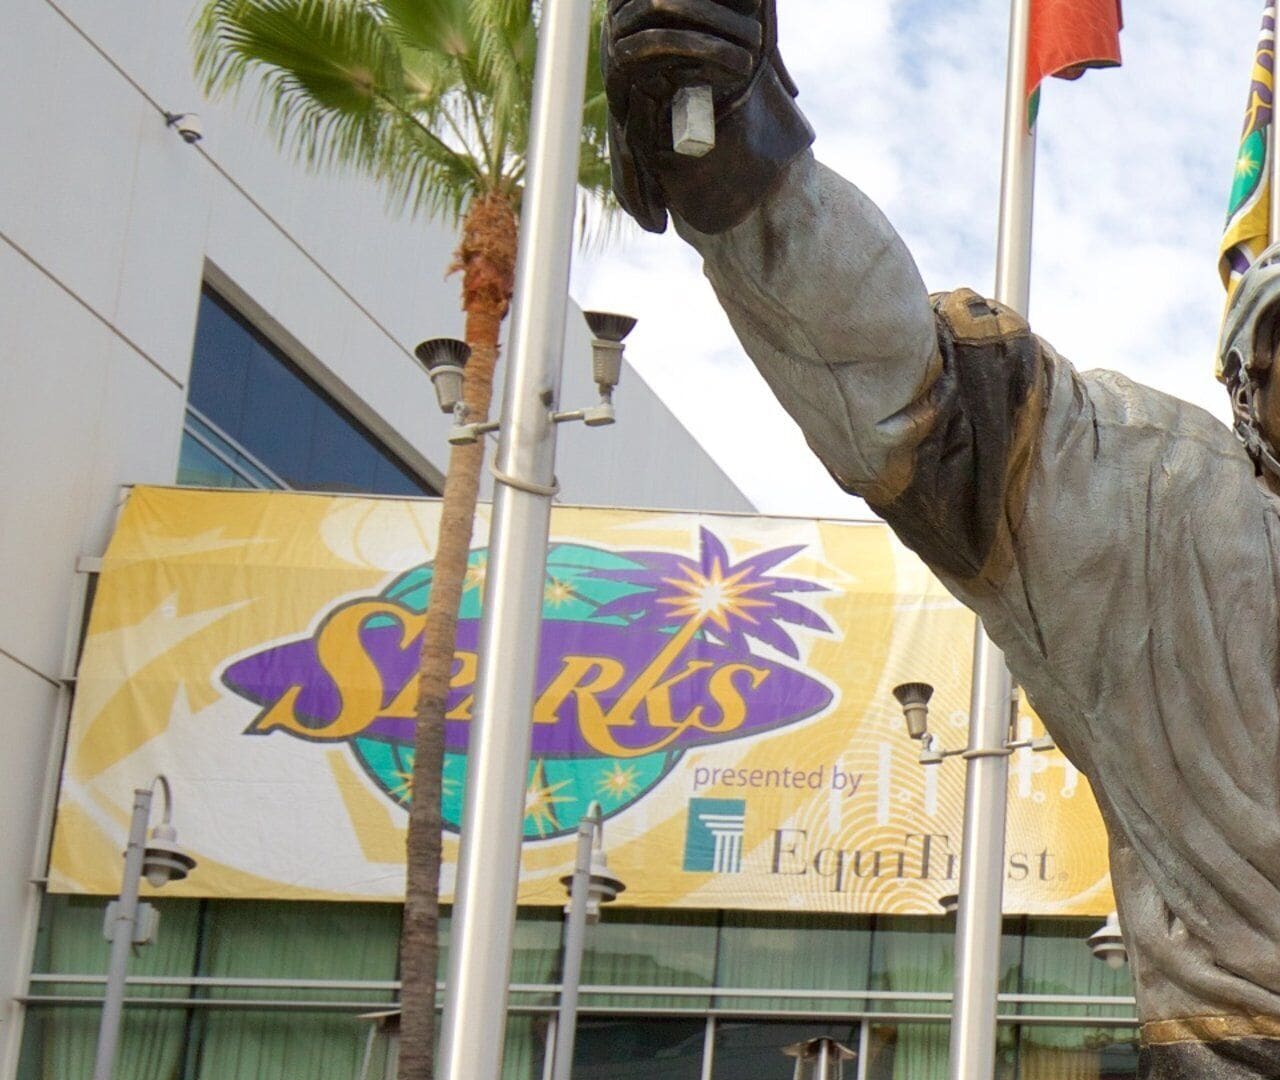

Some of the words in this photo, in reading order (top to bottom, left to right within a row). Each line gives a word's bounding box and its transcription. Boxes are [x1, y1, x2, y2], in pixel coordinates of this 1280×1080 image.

[250, 598, 774, 760] SPRKS
[692, 764, 823, 791] presented
[831, 766, 864, 797] by
[768, 828, 1057, 893] EquiTrst
